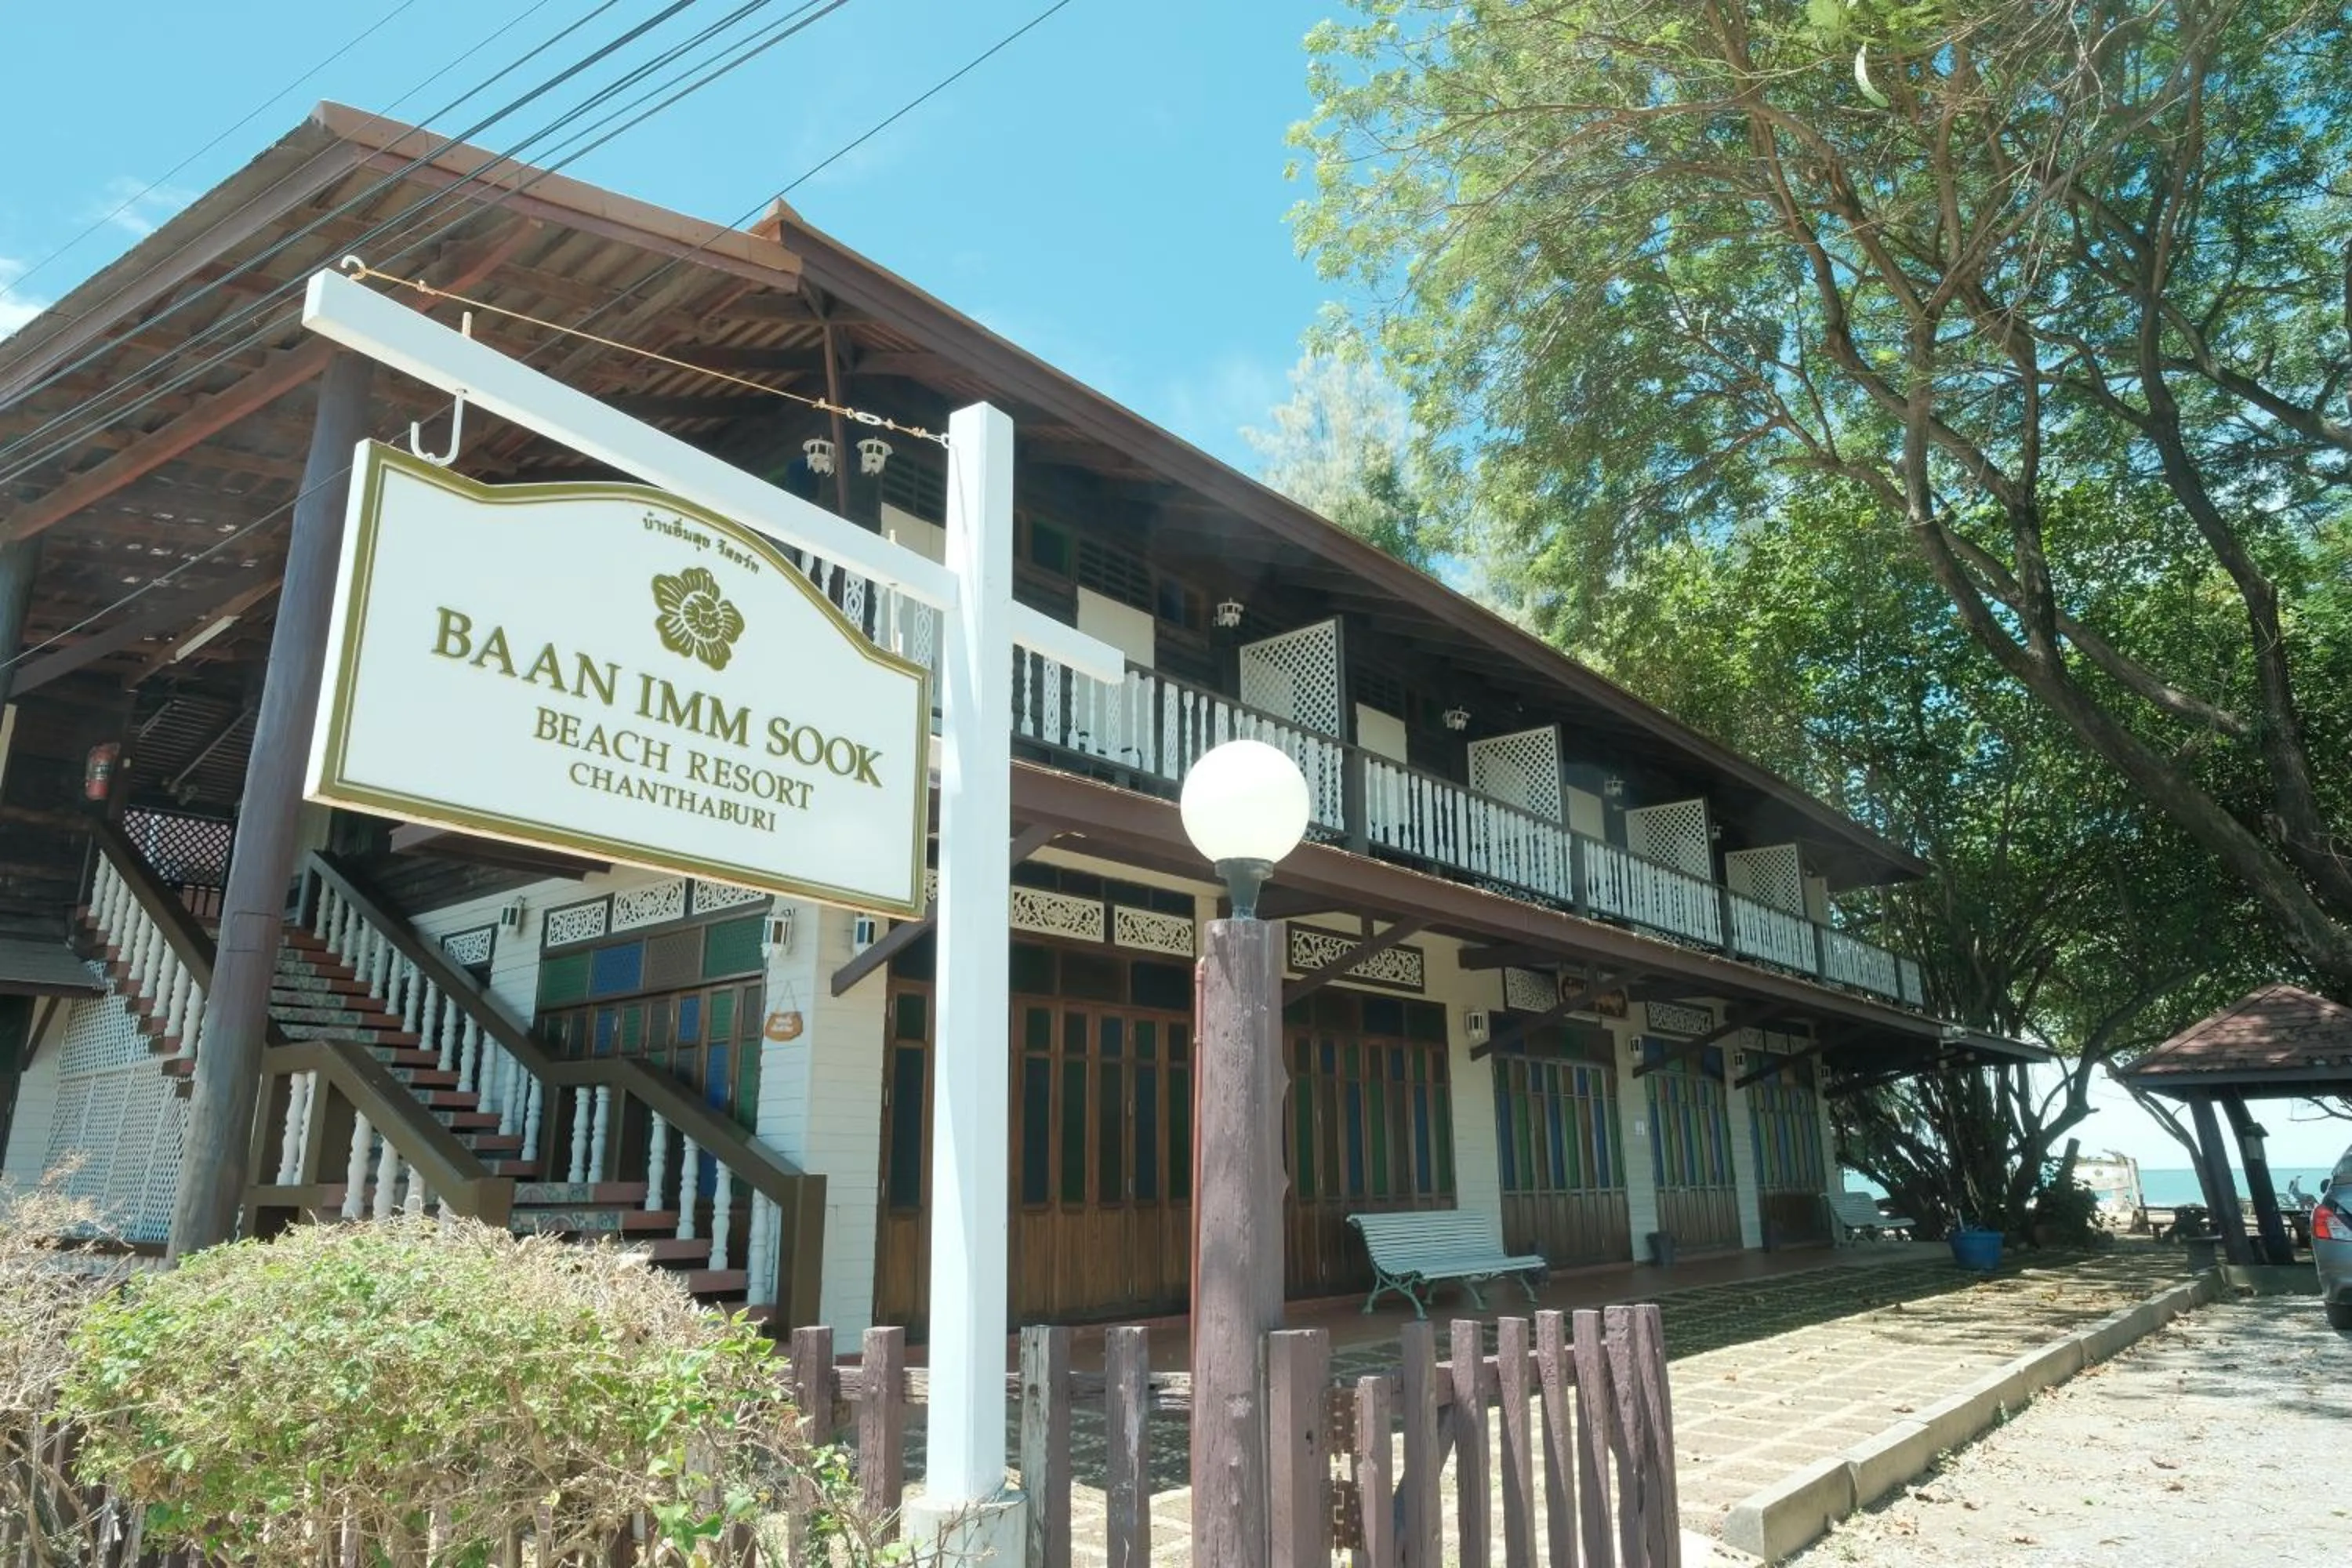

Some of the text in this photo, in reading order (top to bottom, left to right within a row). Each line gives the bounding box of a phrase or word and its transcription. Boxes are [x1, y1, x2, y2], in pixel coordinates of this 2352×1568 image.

[431, 606, 884, 789] BAAN IMM SOOK
[533, 706, 814, 811] BEACH RESORT
[568, 762, 776, 833] CHANTHABURI
